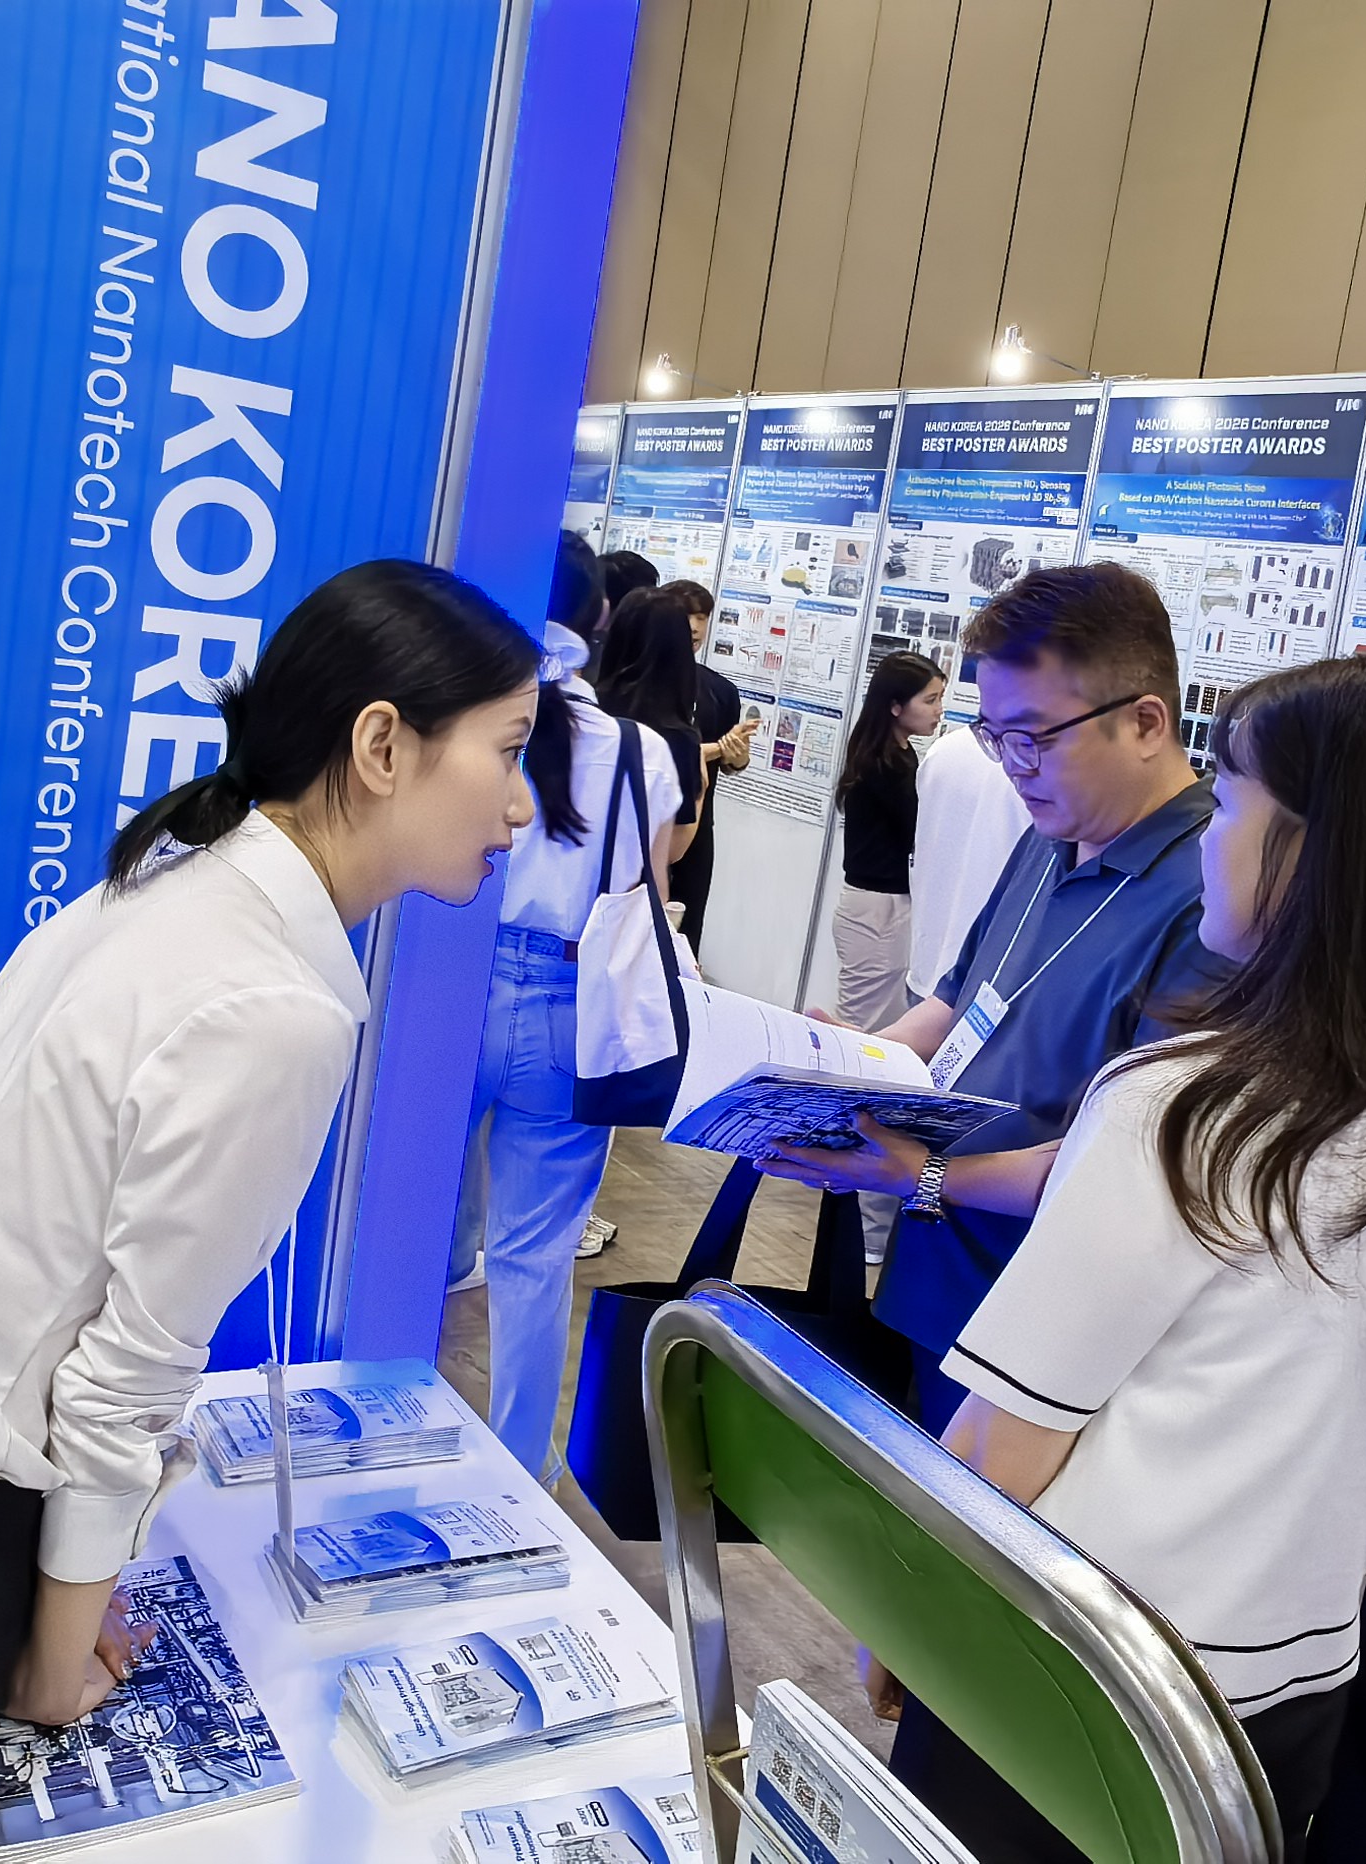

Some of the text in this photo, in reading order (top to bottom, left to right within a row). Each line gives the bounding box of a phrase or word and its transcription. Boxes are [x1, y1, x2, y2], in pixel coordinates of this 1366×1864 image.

[69, 225, 160, 550] Nanotech
[950, 421, 982, 432] KOREA
[1012, 419, 1070, 432] Conference
[1135, 417, 1330, 431] NANO 2026 Conference
[760, 438, 873, 452] BEST POSTER AWARDS
[922, 437, 1068, 452] BEST POSTER AWARDS
[1131, 437, 1327, 455] BEST POSTER AWARDS
[115, 362, 293, 833] KORE
[23, 564, 119, 929] Conference
